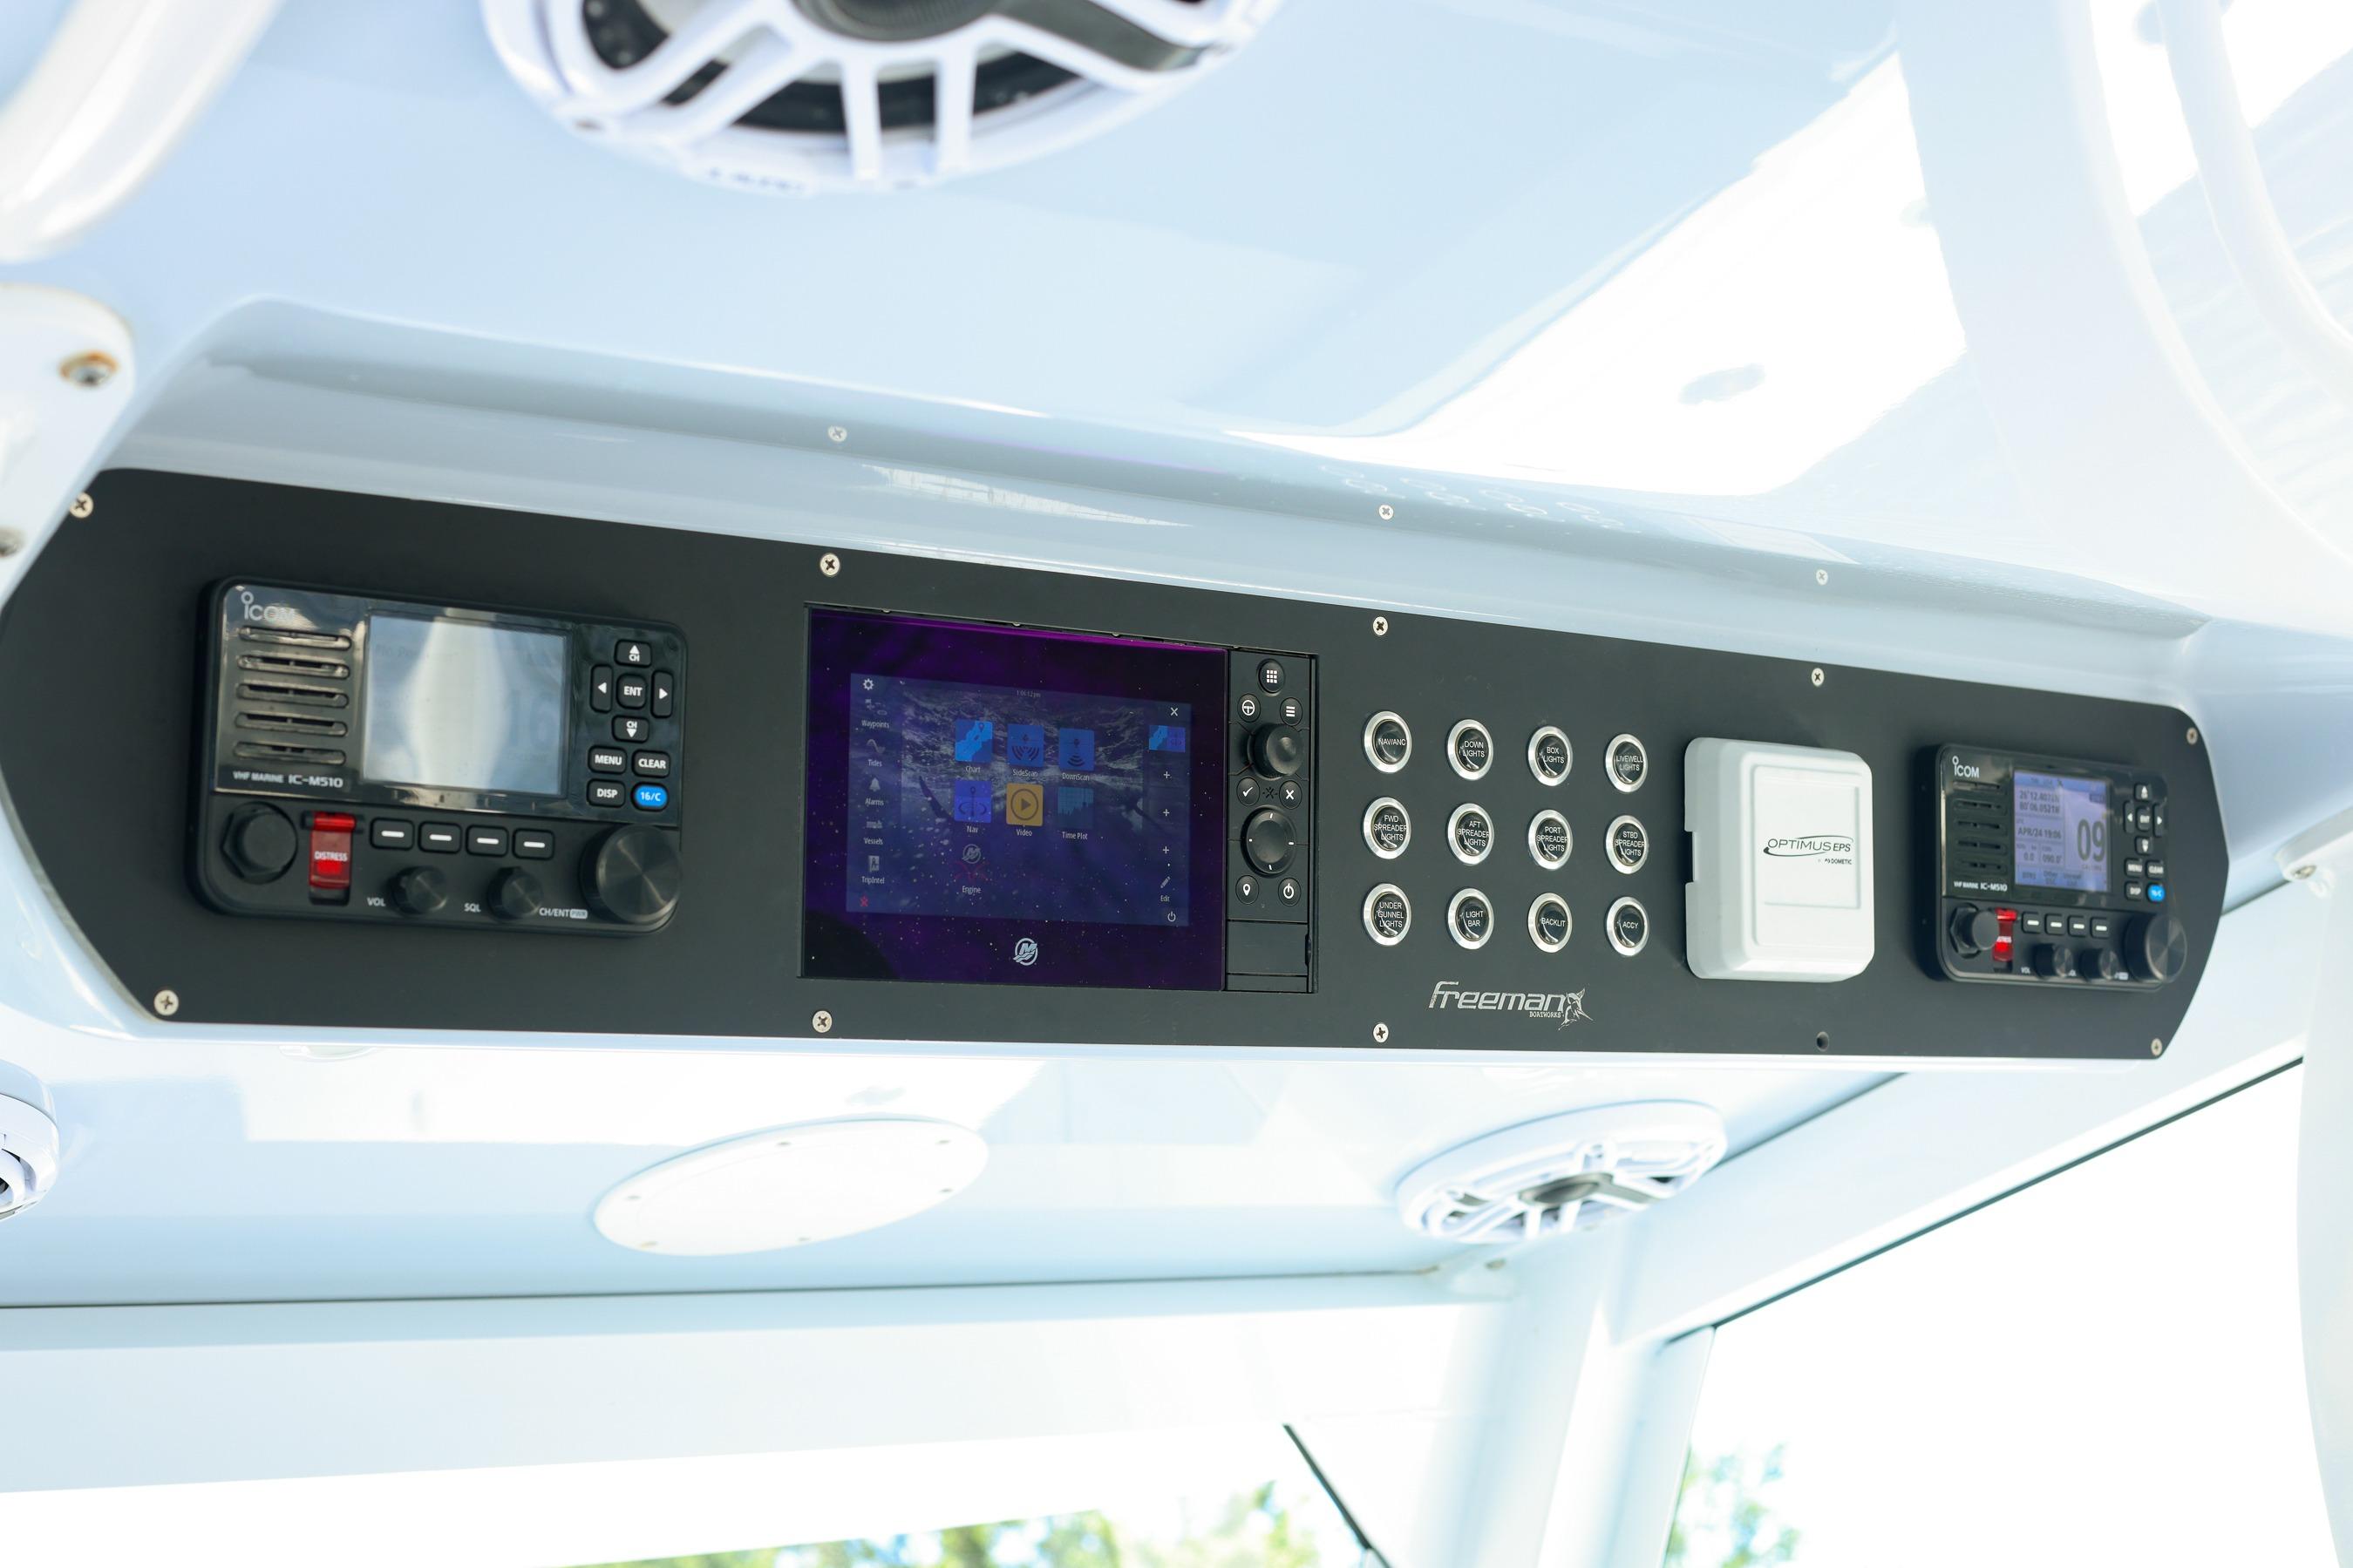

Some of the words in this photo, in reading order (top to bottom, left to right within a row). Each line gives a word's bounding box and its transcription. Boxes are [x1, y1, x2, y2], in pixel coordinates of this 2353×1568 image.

[623, 685, 643, 696] ENT
[861, 720, 889, 730] Waypoints
[595, 754, 622, 765] MENU
[638, 758, 666, 769] CLEAR
[867, 758, 882, 767] Tides
[1012, 769, 1038, 777] SideScan
[1062, 772, 1090, 781] DownScan
[251, 772, 283, 783] MARINE
[288, 774, 343, 788] IC-M510
[596, 788, 618, 798] DISP
[640, 791, 661, 801] 16/C
[865, 798, 884, 806] Alarms
[1062, 831, 1076, 839] Time
[1077, 832, 1088, 840] Plot
[1457, 829, 1490, 838] SPREADER
[1537, 834, 1568, 843] SPREADER
[1465, 838, 1486, 847] LIGHTS
[1615, 838, 1645, 848] SPREADER
[1767, 838, 1832, 852] OPTIMUS
[1833, 843, 1851, 852] EPS
[2078, 818, 2105, 863] 09
[314, 851, 348, 862] DISTRESS
[962, 886, 982, 895] Engine
[1980, 882, 2008, 892] IC-M510
[367, 898, 385, 906] VOL
[464, 902, 481, 913] SQL
[1379, 920, 1403, 928] LIGHTS
[1541, 917, 1566, 927] BACKLIT
